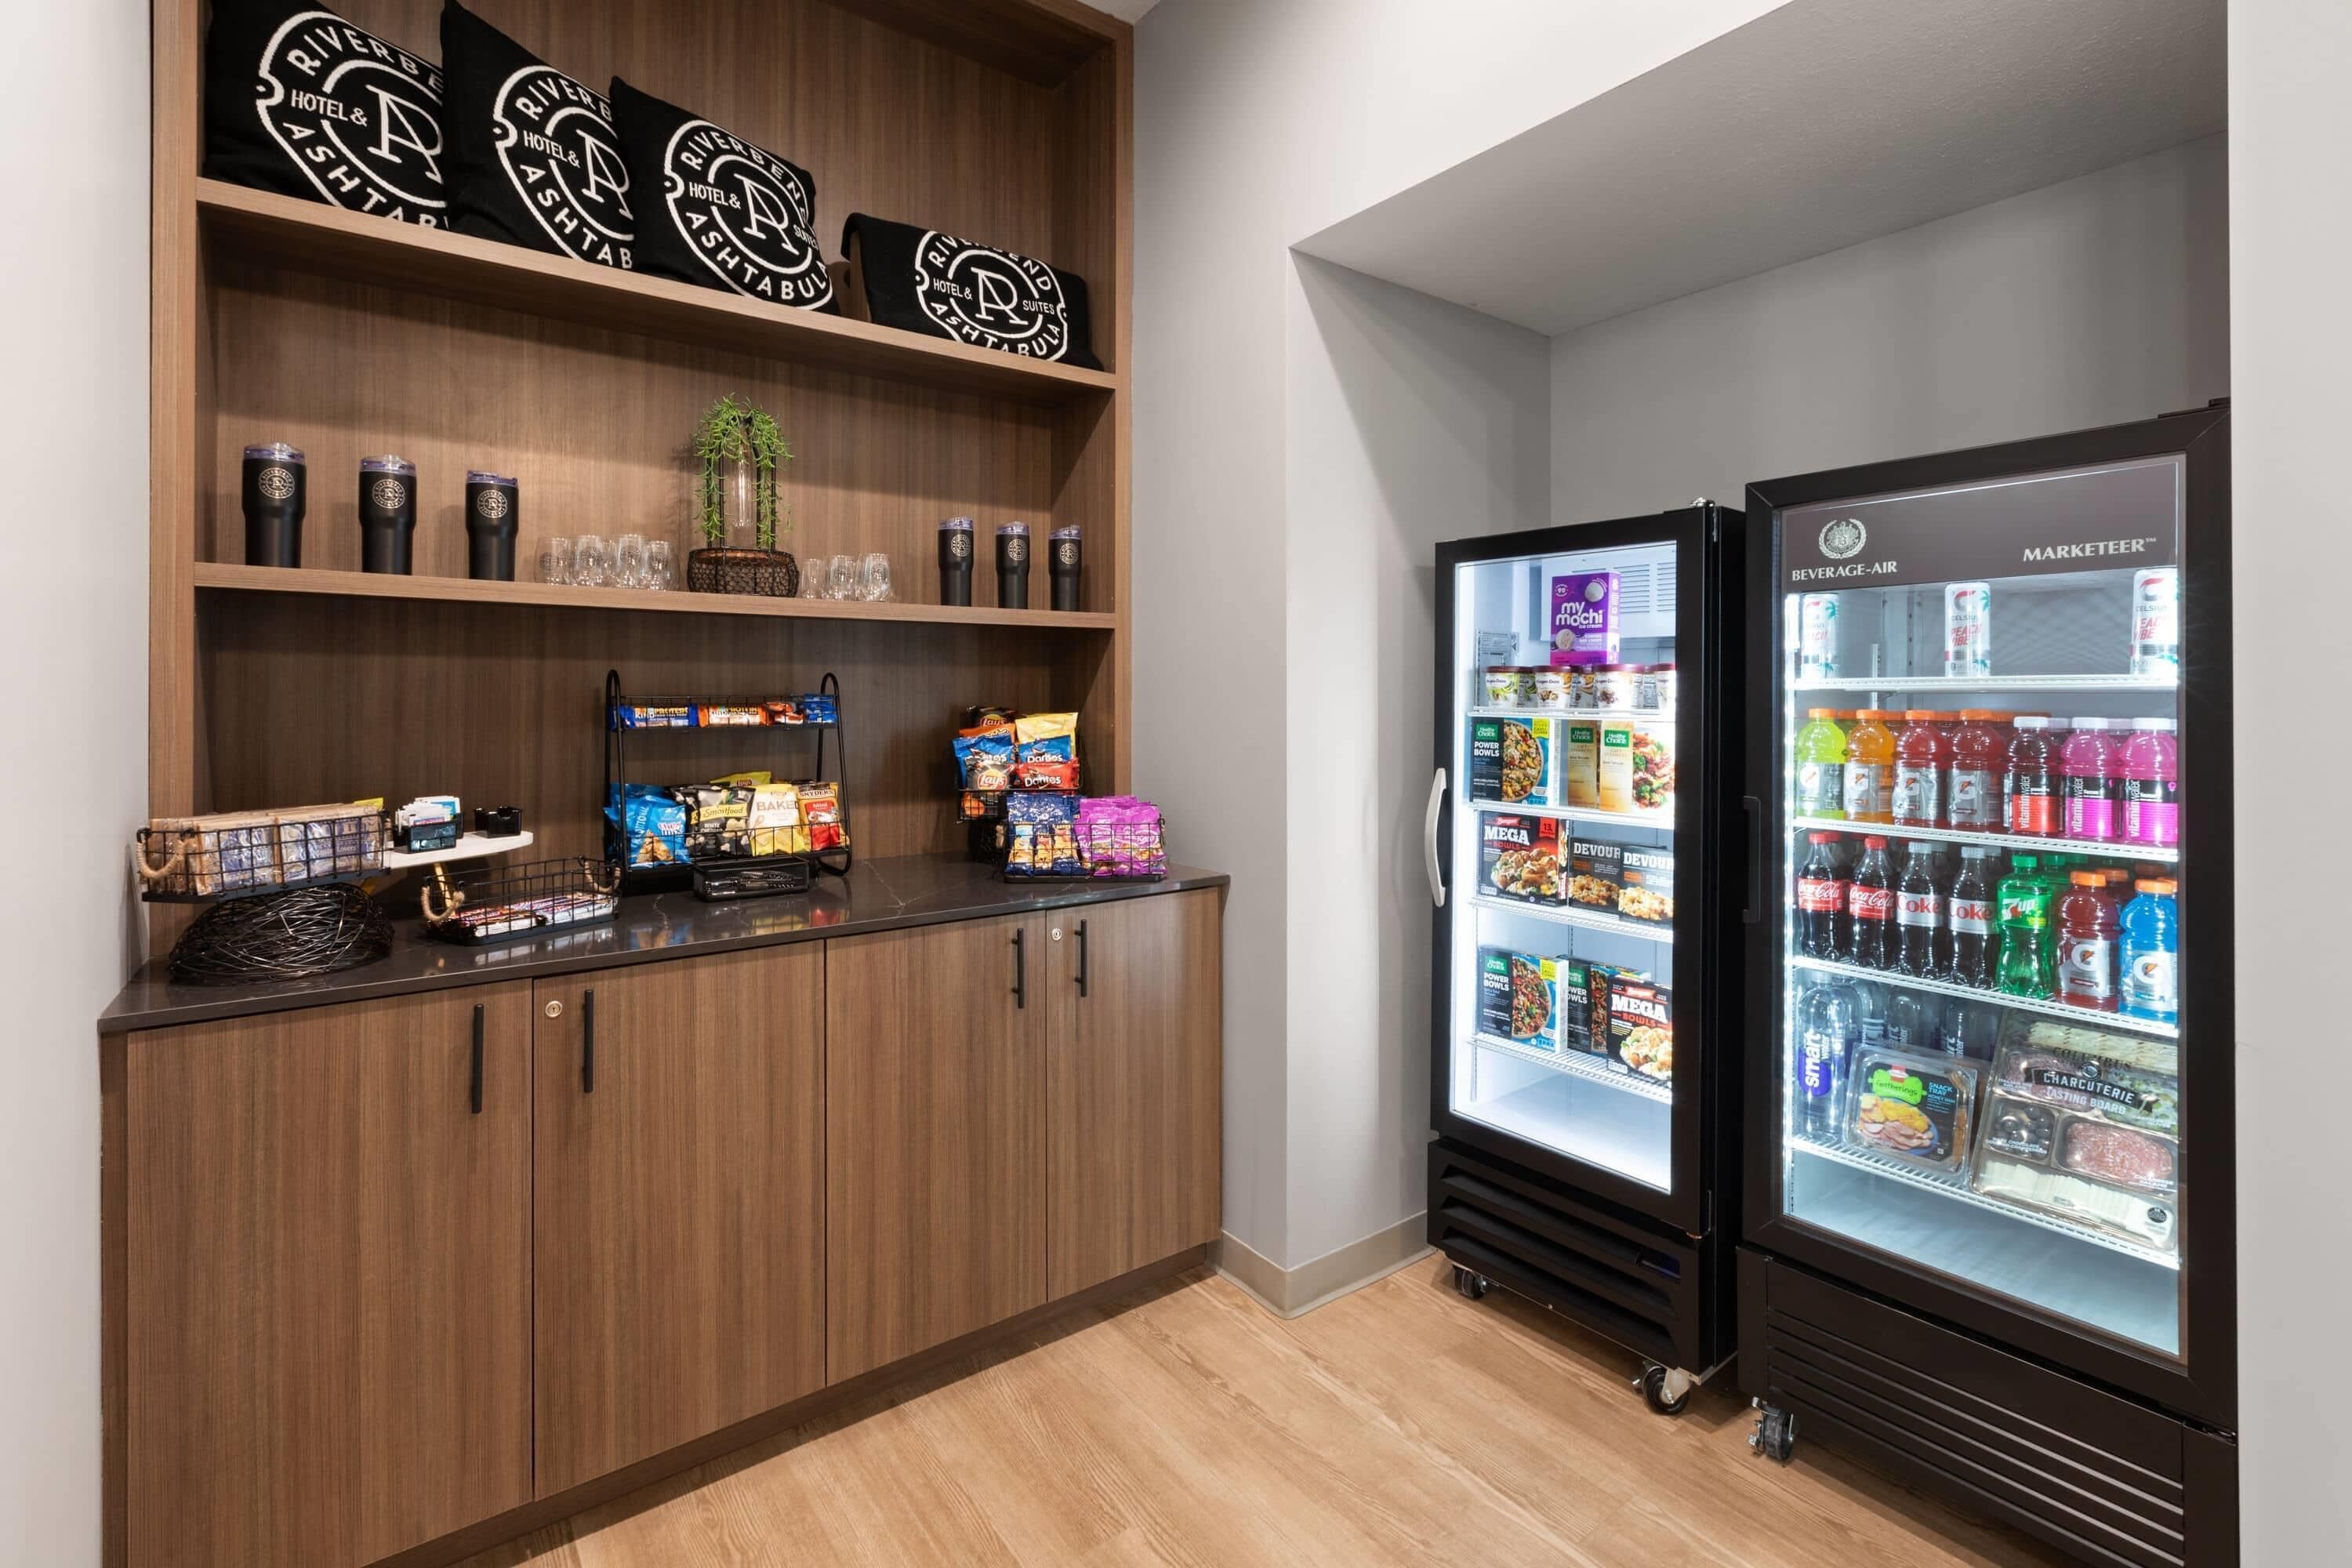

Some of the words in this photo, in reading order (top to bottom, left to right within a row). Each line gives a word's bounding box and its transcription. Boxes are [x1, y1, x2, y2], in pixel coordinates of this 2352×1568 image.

[291, 89, 349, 122] HOTEL
[522, 129, 568, 158] HOTEL
[283, 122, 448, 230] ASHTAB
[689, 181, 728, 206] HOTEL
[685, 212, 829, 300] ASHTABULA
[933, 278, 963, 299] HOTEL
[964, 286, 973, 301] &
[1022, 299, 1055, 315] SUITES
[1791, 561, 1898, 582] BEVERAGE-AIR
[1555, 608, 1603, 626] mochi
[1561, 601, 1585, 616] my
[1474, 741, 1499, 750] POWER
[1474, 749, 1500, 757] BOWLS
[1027, 753, 1063, 763] Doritos
[1025, 775, 1062, 786] Doritos
[2019, 775, 2031, 829] vitaminwater
[2071, 776, 2083, 833] vitaminwater
[2129, 779, 2140, 837] vitaminwater
[703, 808, 744, 818] Smartfood
[1484, 826, 1530, 846] MEGA
[1493, 840, 1521, 851] BOWLS
[1849, 885, 1895, 907] Coca-Cola
[1896, 895, 1939, 914] Coke
[1483, 972, 1509, 983] POWER
[1483, 979, 1509, 991] BOWLS
[1611, 994, 1668, 1024] MEGA
[1622, 1012, 1656, 1026] BOWLS
[1805, 1028, 1820, 1088] smart
[1875, 1080, 1918, 1097] Gatherings
[1929, 1081, 1953, 1092] SNACK
[1929, 1087, 1947, 1096] TRAY
[2043, 1073, 2136, 1104] CHARCUTERIE
[2045, 1087, 2087, 1105] TASTING
[2090, 1098, 2126, 1115] BOARD
